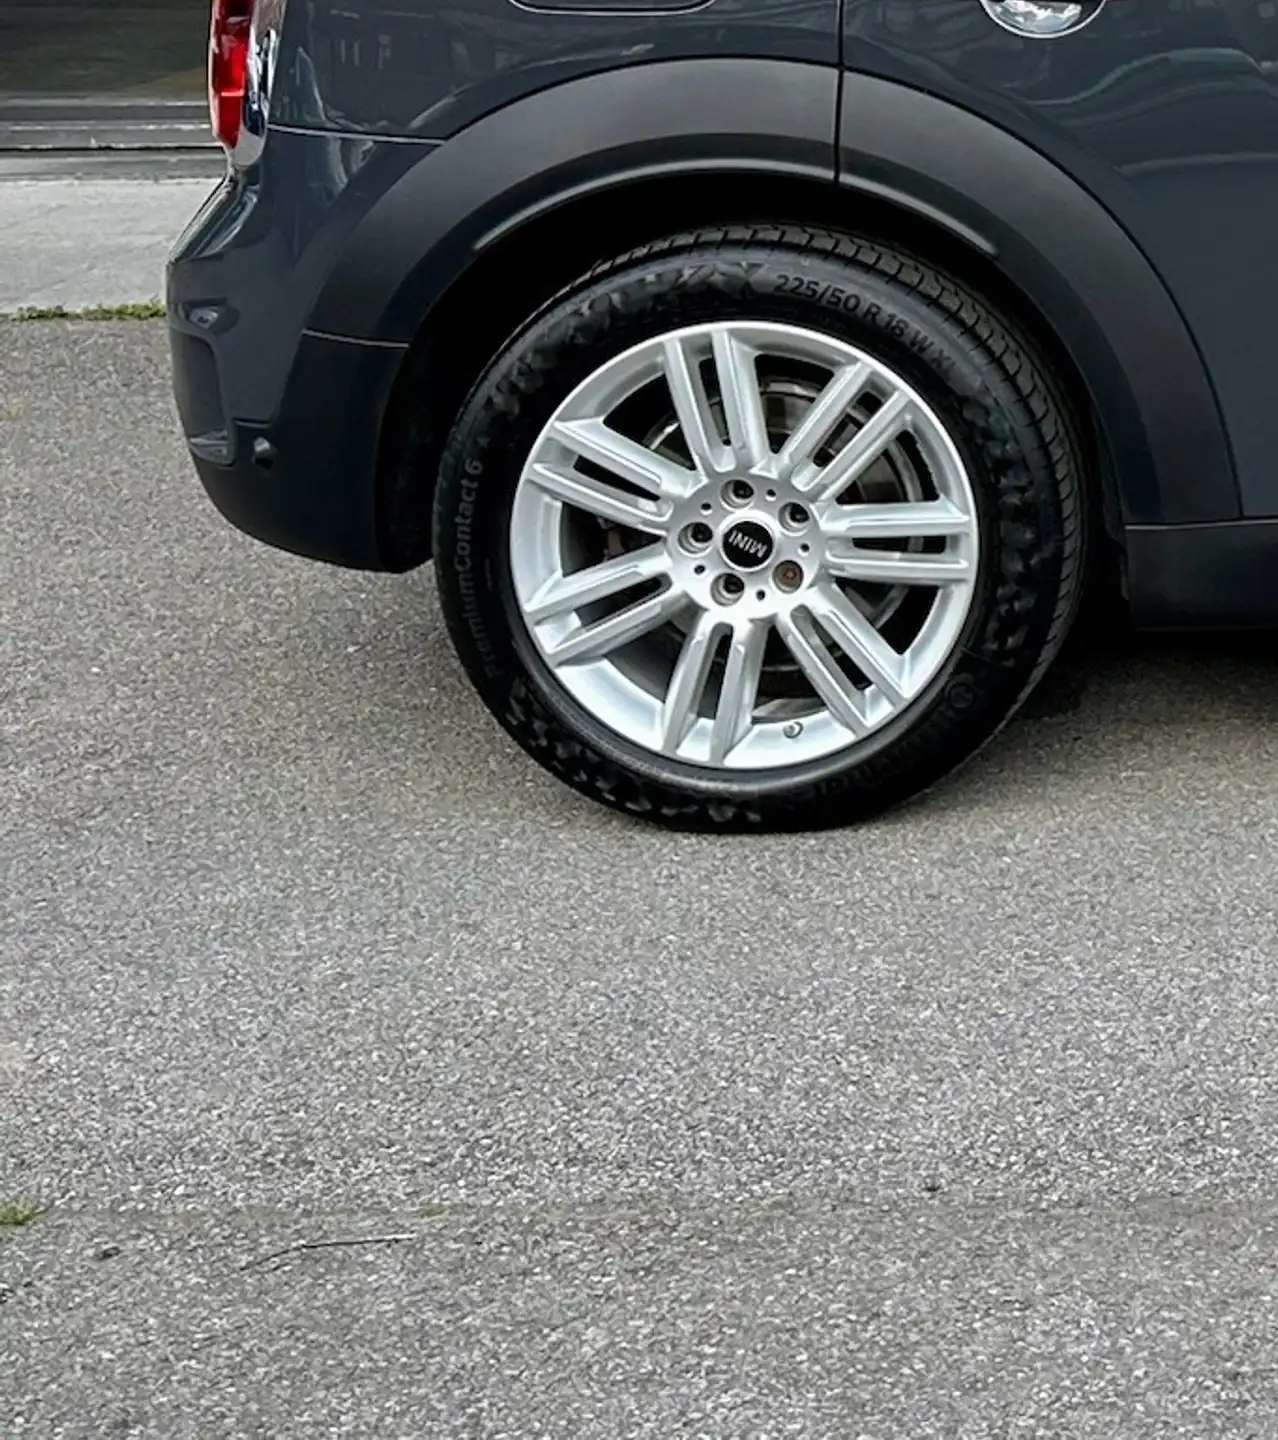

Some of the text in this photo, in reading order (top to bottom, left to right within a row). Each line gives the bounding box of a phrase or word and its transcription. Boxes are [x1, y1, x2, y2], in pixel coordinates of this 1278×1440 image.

[774, 274, 861, 313] 225/50
[864, 302, 881, 325] R
[883, 312, 910, 339] 18
[728, 530, 768, 558] MINI
